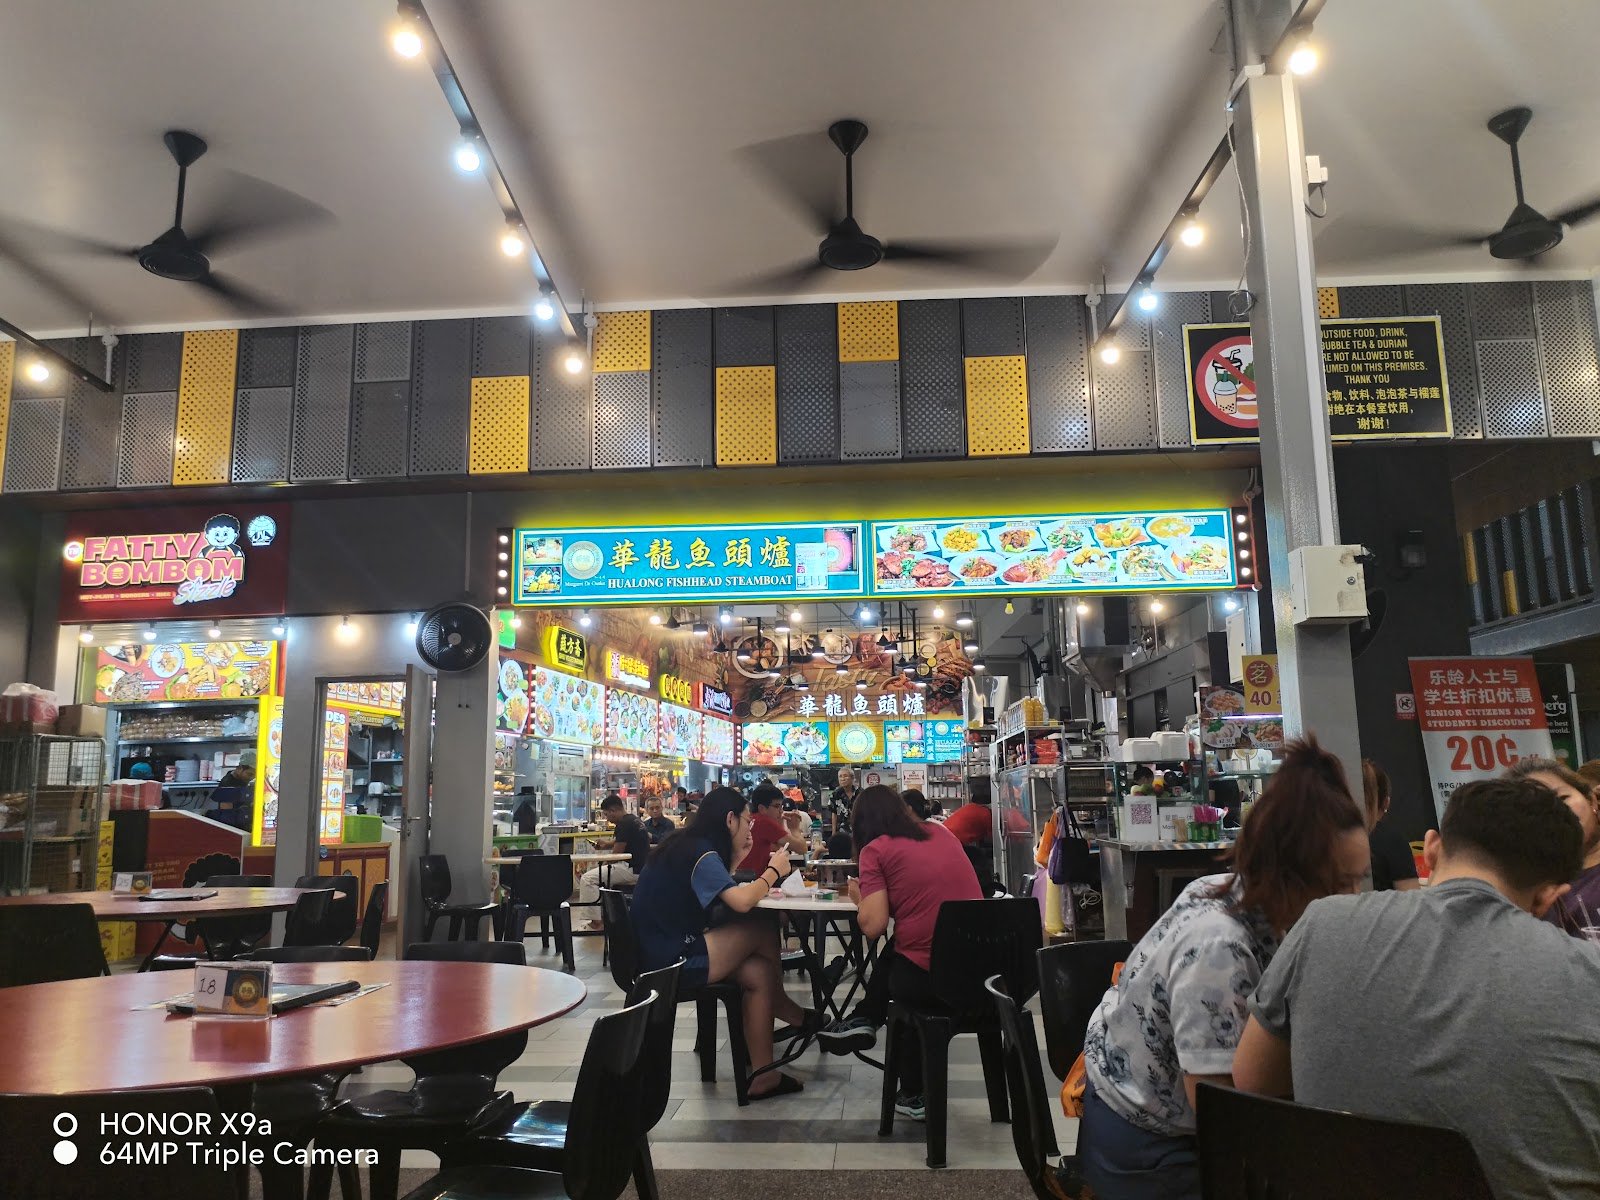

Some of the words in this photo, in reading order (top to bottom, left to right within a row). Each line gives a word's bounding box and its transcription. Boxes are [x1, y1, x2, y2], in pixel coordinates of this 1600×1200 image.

[1353, 328, 1379, 338] FOOD,
[1380, 327, 1408, 337] DRINK,
[1321, 340, 1351, 351] BUBBLE
[1352, 340, 1367, 350] TEA
[1369, 339, 1375, 349] &
[1377, 338, 1408, 349] DURIAN
[1333, 352, 1349, 362] NOT
[1352, 350, 1390, 361] ALLOWED
[1391, 350, 1402, 360] TO
[1404, 349, 1415, 360] BE
[1324, 363, 1349, 374] UMED
[1351, 363, 1362, 373] ON
[1364, 362, 1383, 372] THIS
[1384, 361, 1428, 372] PREMISES.
[1344, 374, 1371, 385] THANK
[1372, 374, 1390, 384] YOU
[83, 533, 200, 562] FATTY
[607, 535, 793, 575] 華龍魚頭爐
[80, 557, 244, 587] BOMBOM
[607, 577, 664, 589] HUALONG
[666, 576, 723, 588] FISHHEAD
[725, 574, 793, 587] STEAMBOAT
[173, 576, 237, 605] Sizzle
[1429, 668, 1519, 686] 乐龄人士与
[1249, 690, 1272, 706] 40
[1423, 687, 1534, 705] 学生折扣优惠
[796, 692, 927, 718] 華龍魚頭爐
[1544, 701, 1567, 715] erg
[1425, 709, 1463, 718] SENIOR
[1466, 708, 1511, 717] CITIZENS
[1514, 708, 1536, 716] AND
[1427, 719, 1478, 728] STUDENTS
[1480, 718, 1531, 727] DISCOUNT
[198, 977, 217, 995] 18
